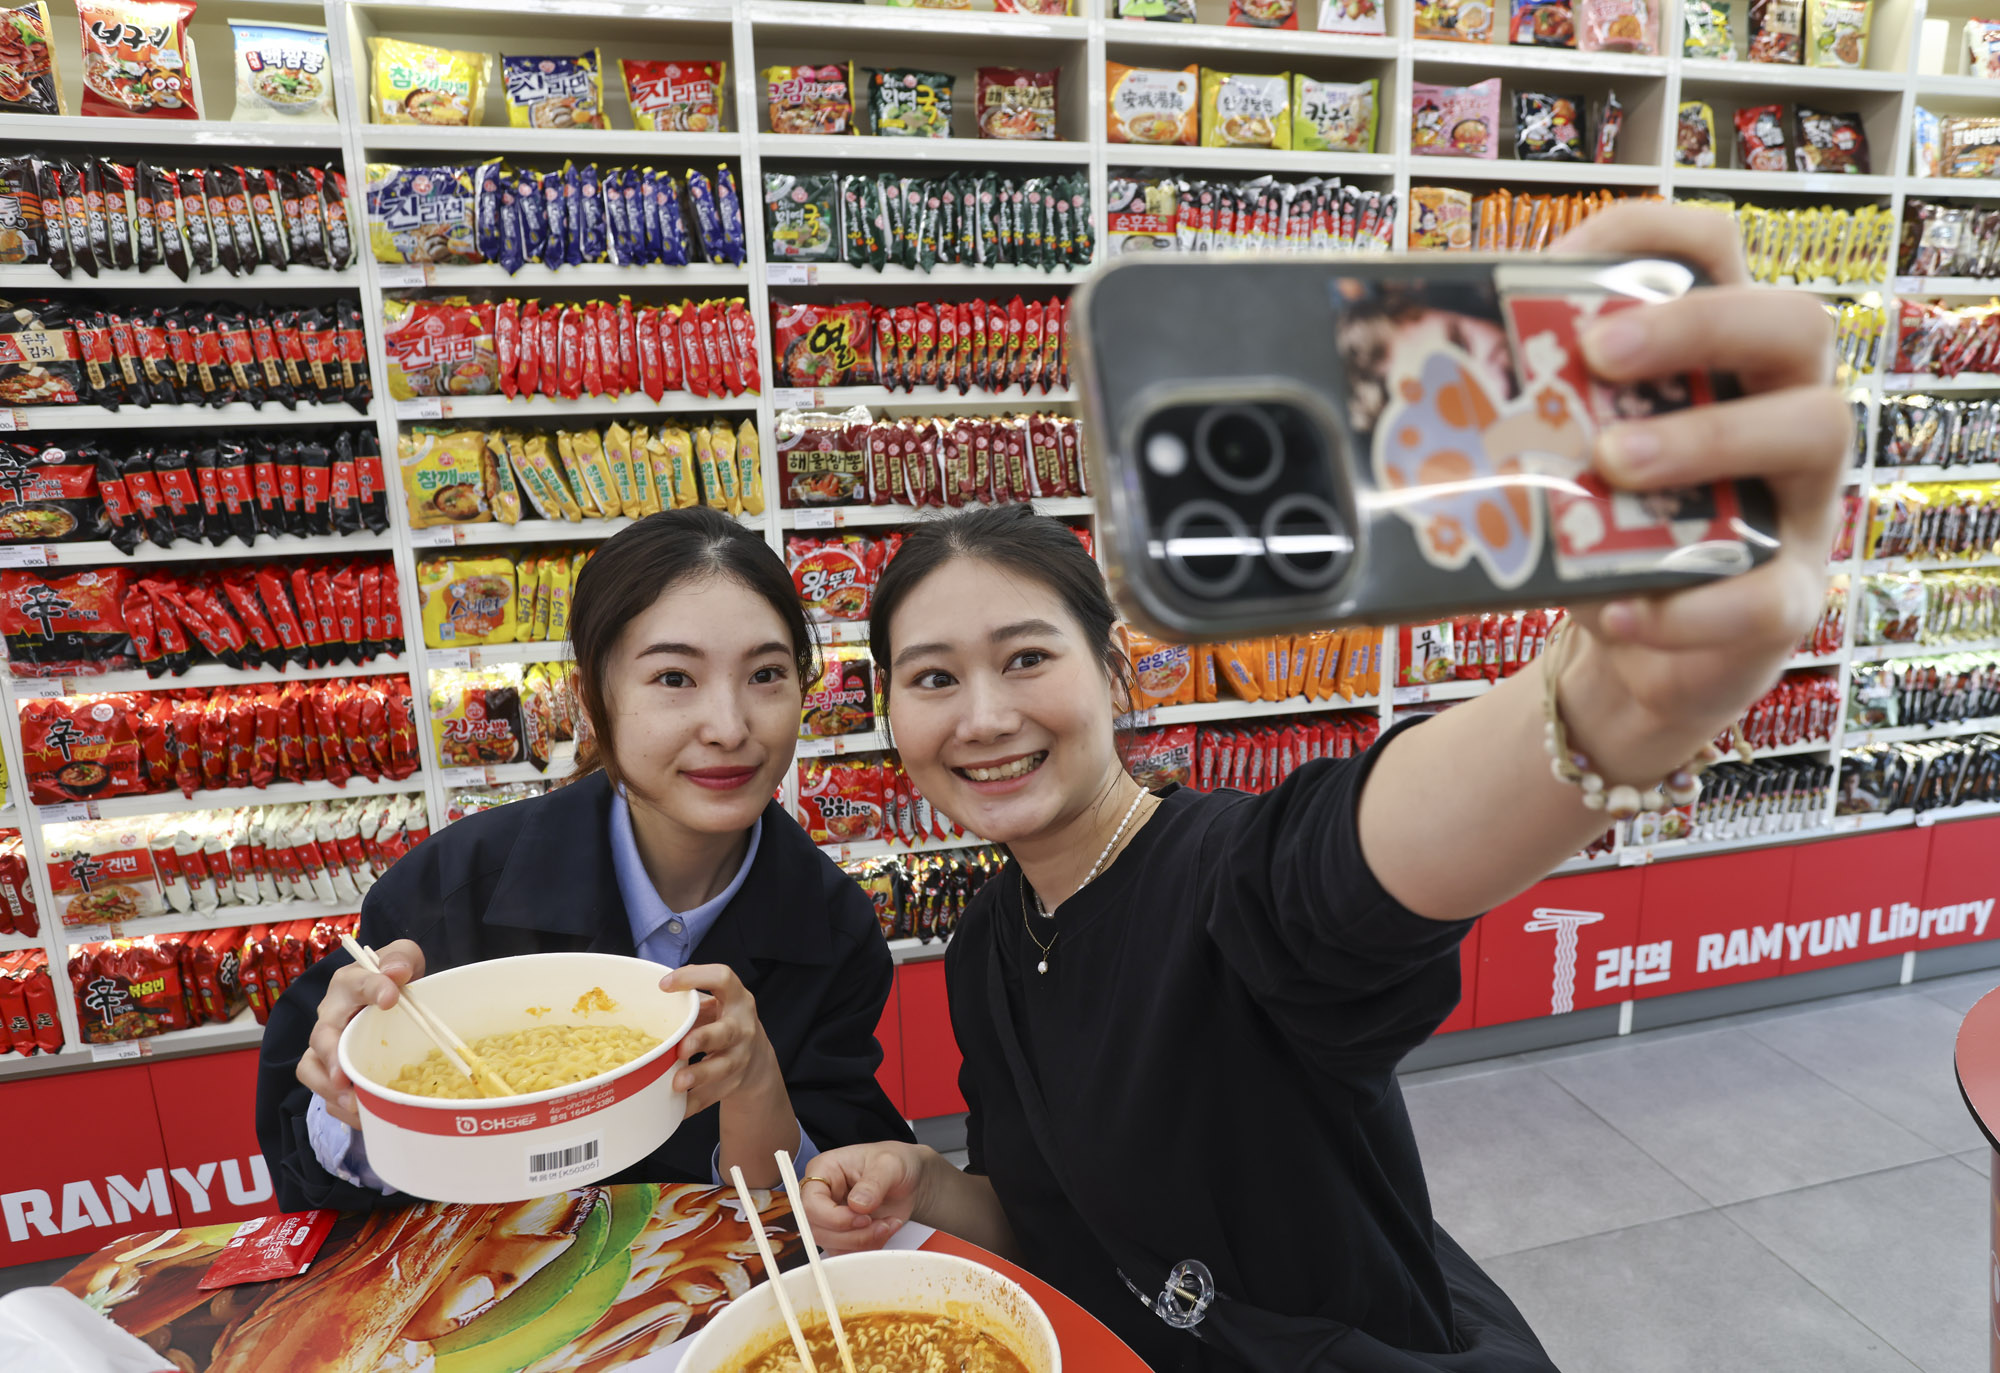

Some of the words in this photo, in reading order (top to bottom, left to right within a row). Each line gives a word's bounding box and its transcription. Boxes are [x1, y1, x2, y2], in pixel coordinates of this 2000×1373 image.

[91, 21, 171, 48] 너구리
[260, 47, 324, 74] 백짬뽕
[510, 71, 590, 106] 진라면
[636, 77, 713, 113] 진라면
[382, 193, 466, 233] 진라면
[21, 333, 47, 345] 두부
[28, 346, 54, 358] 김치
[810, 322, 856, 369] 열
[398, 333, 476, 373] 진라면
[787, 450, 865, 473] 해물짬뽕
[416, 469, 479, 488] 참깨라면
[29, 489, 64, 499] BLACK
[801, 568, 857, 601] 왕뚜껑
[21, 584, 74, 641] 辛
[451, 597, 500, 620] 스낵면
[1137, 644, 1189, 672] 삼양라면
[45, 717, 84, 761] 辛
[443, 719, 511, 741] 진짬뽕
[814, 796, 871, 818] 김치라면
[70, 850, 103, 893] 辛
[106, 856, 138, 873] 건면
[1595, 940, 1672, 991] 라면
[1696, 911, 1861, 974] RAMYUN
[1867, 898, 1996, 946] Library
[86, 976, 128, 1026] 辛
[129, 977, 165, 999] 볶음면
[570, 1096, 615, 1118] 1644-3380
